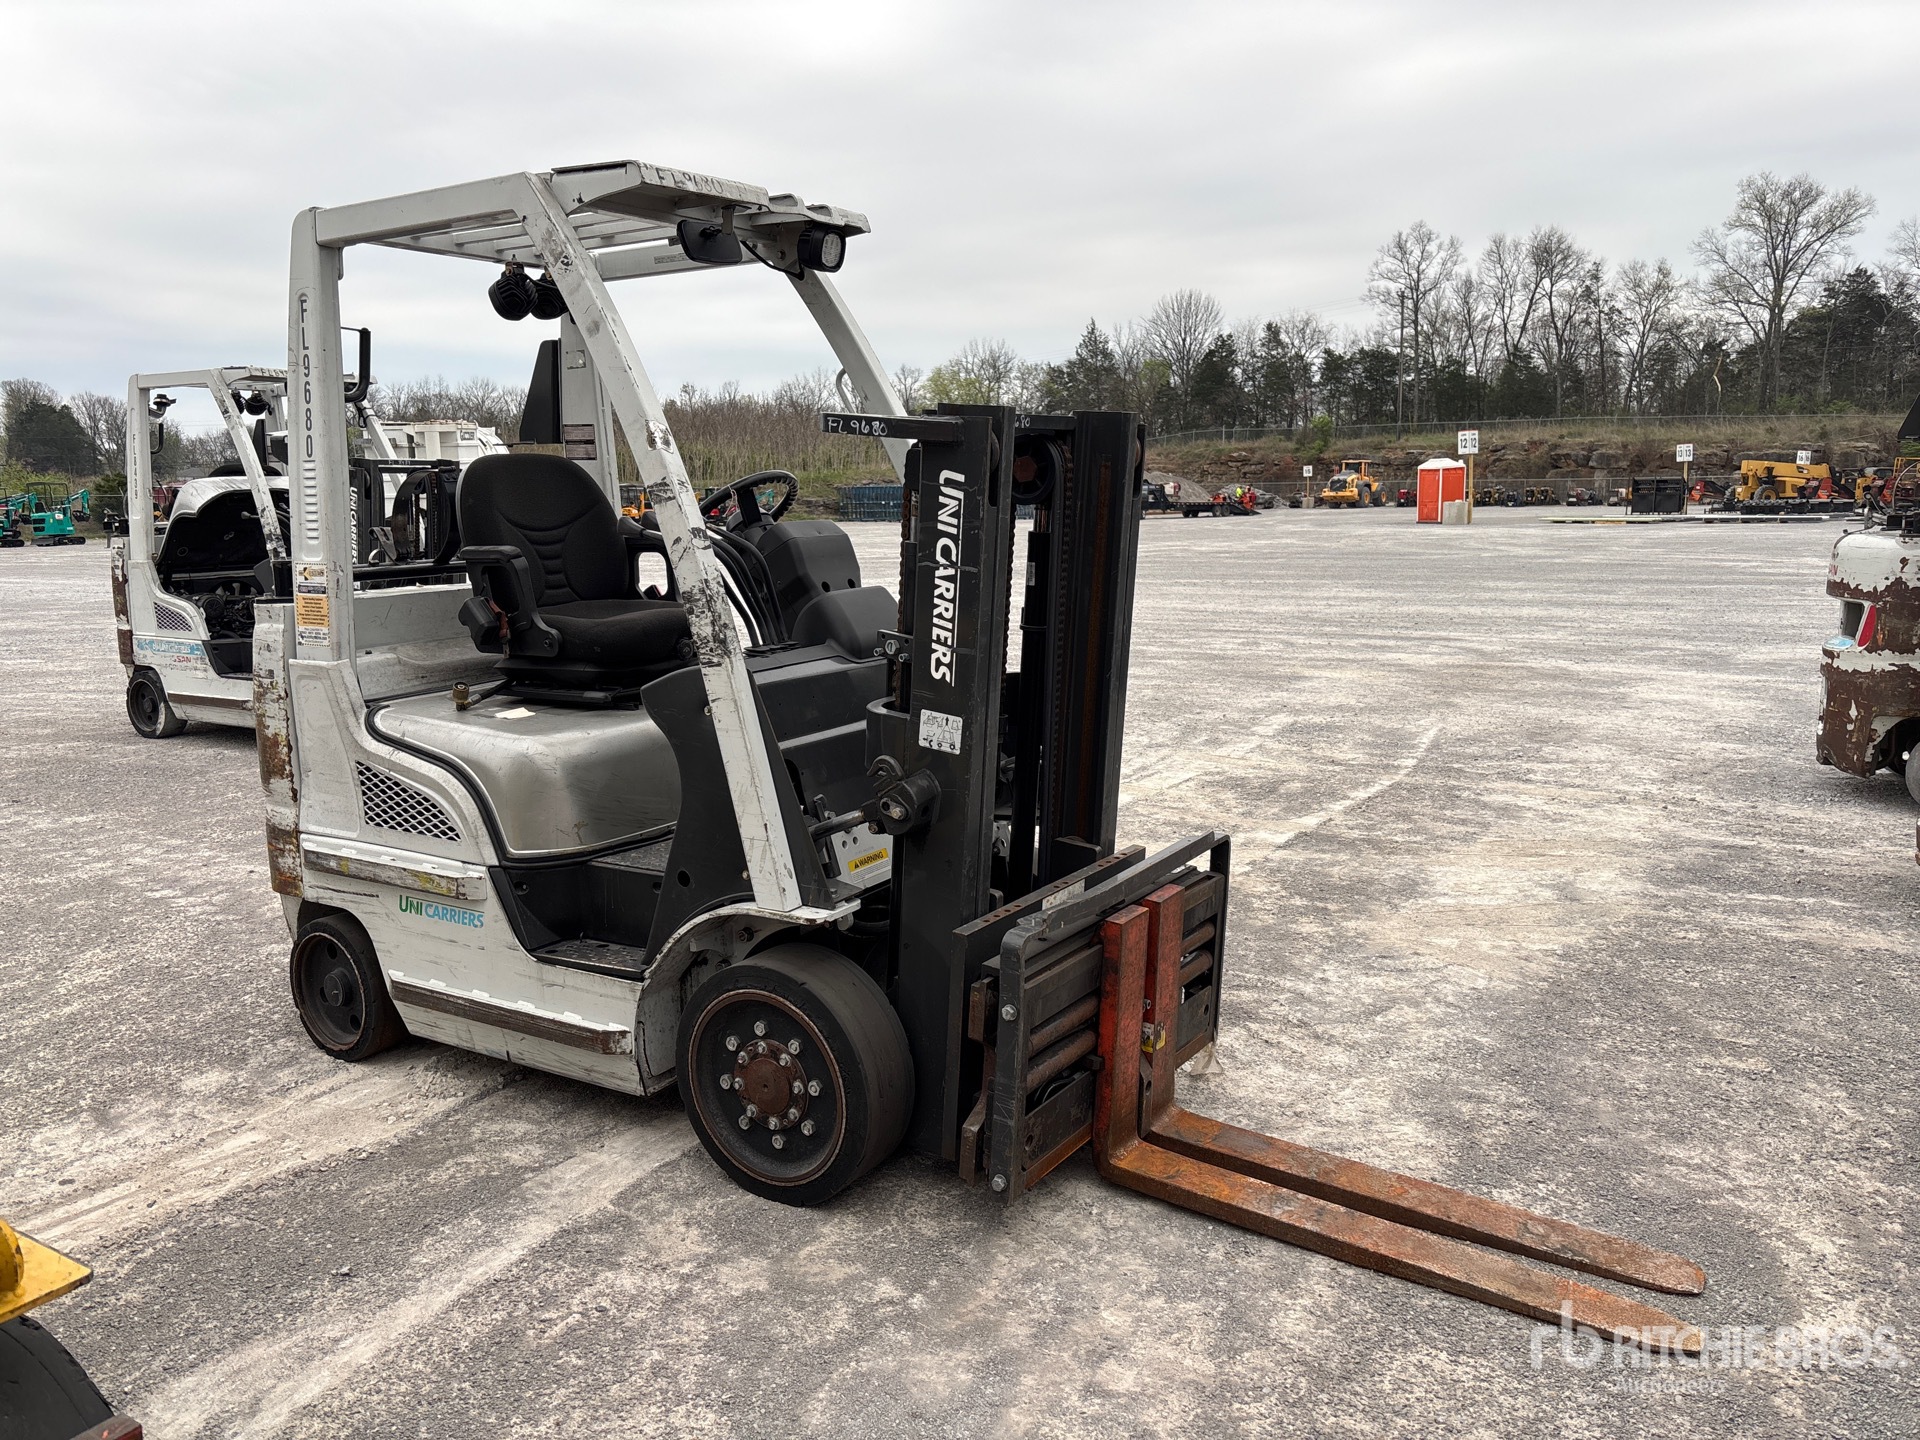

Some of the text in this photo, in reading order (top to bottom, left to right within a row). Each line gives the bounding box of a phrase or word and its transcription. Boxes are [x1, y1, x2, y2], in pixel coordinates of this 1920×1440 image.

[300, 299, 313, 458] FL9680
[1460, 438, 1468, 449] 12
[1470, 437, 1477, 448] 12
[1685, 449, 1691, 457] 13
[859, 851, 884, 867] WARNING
